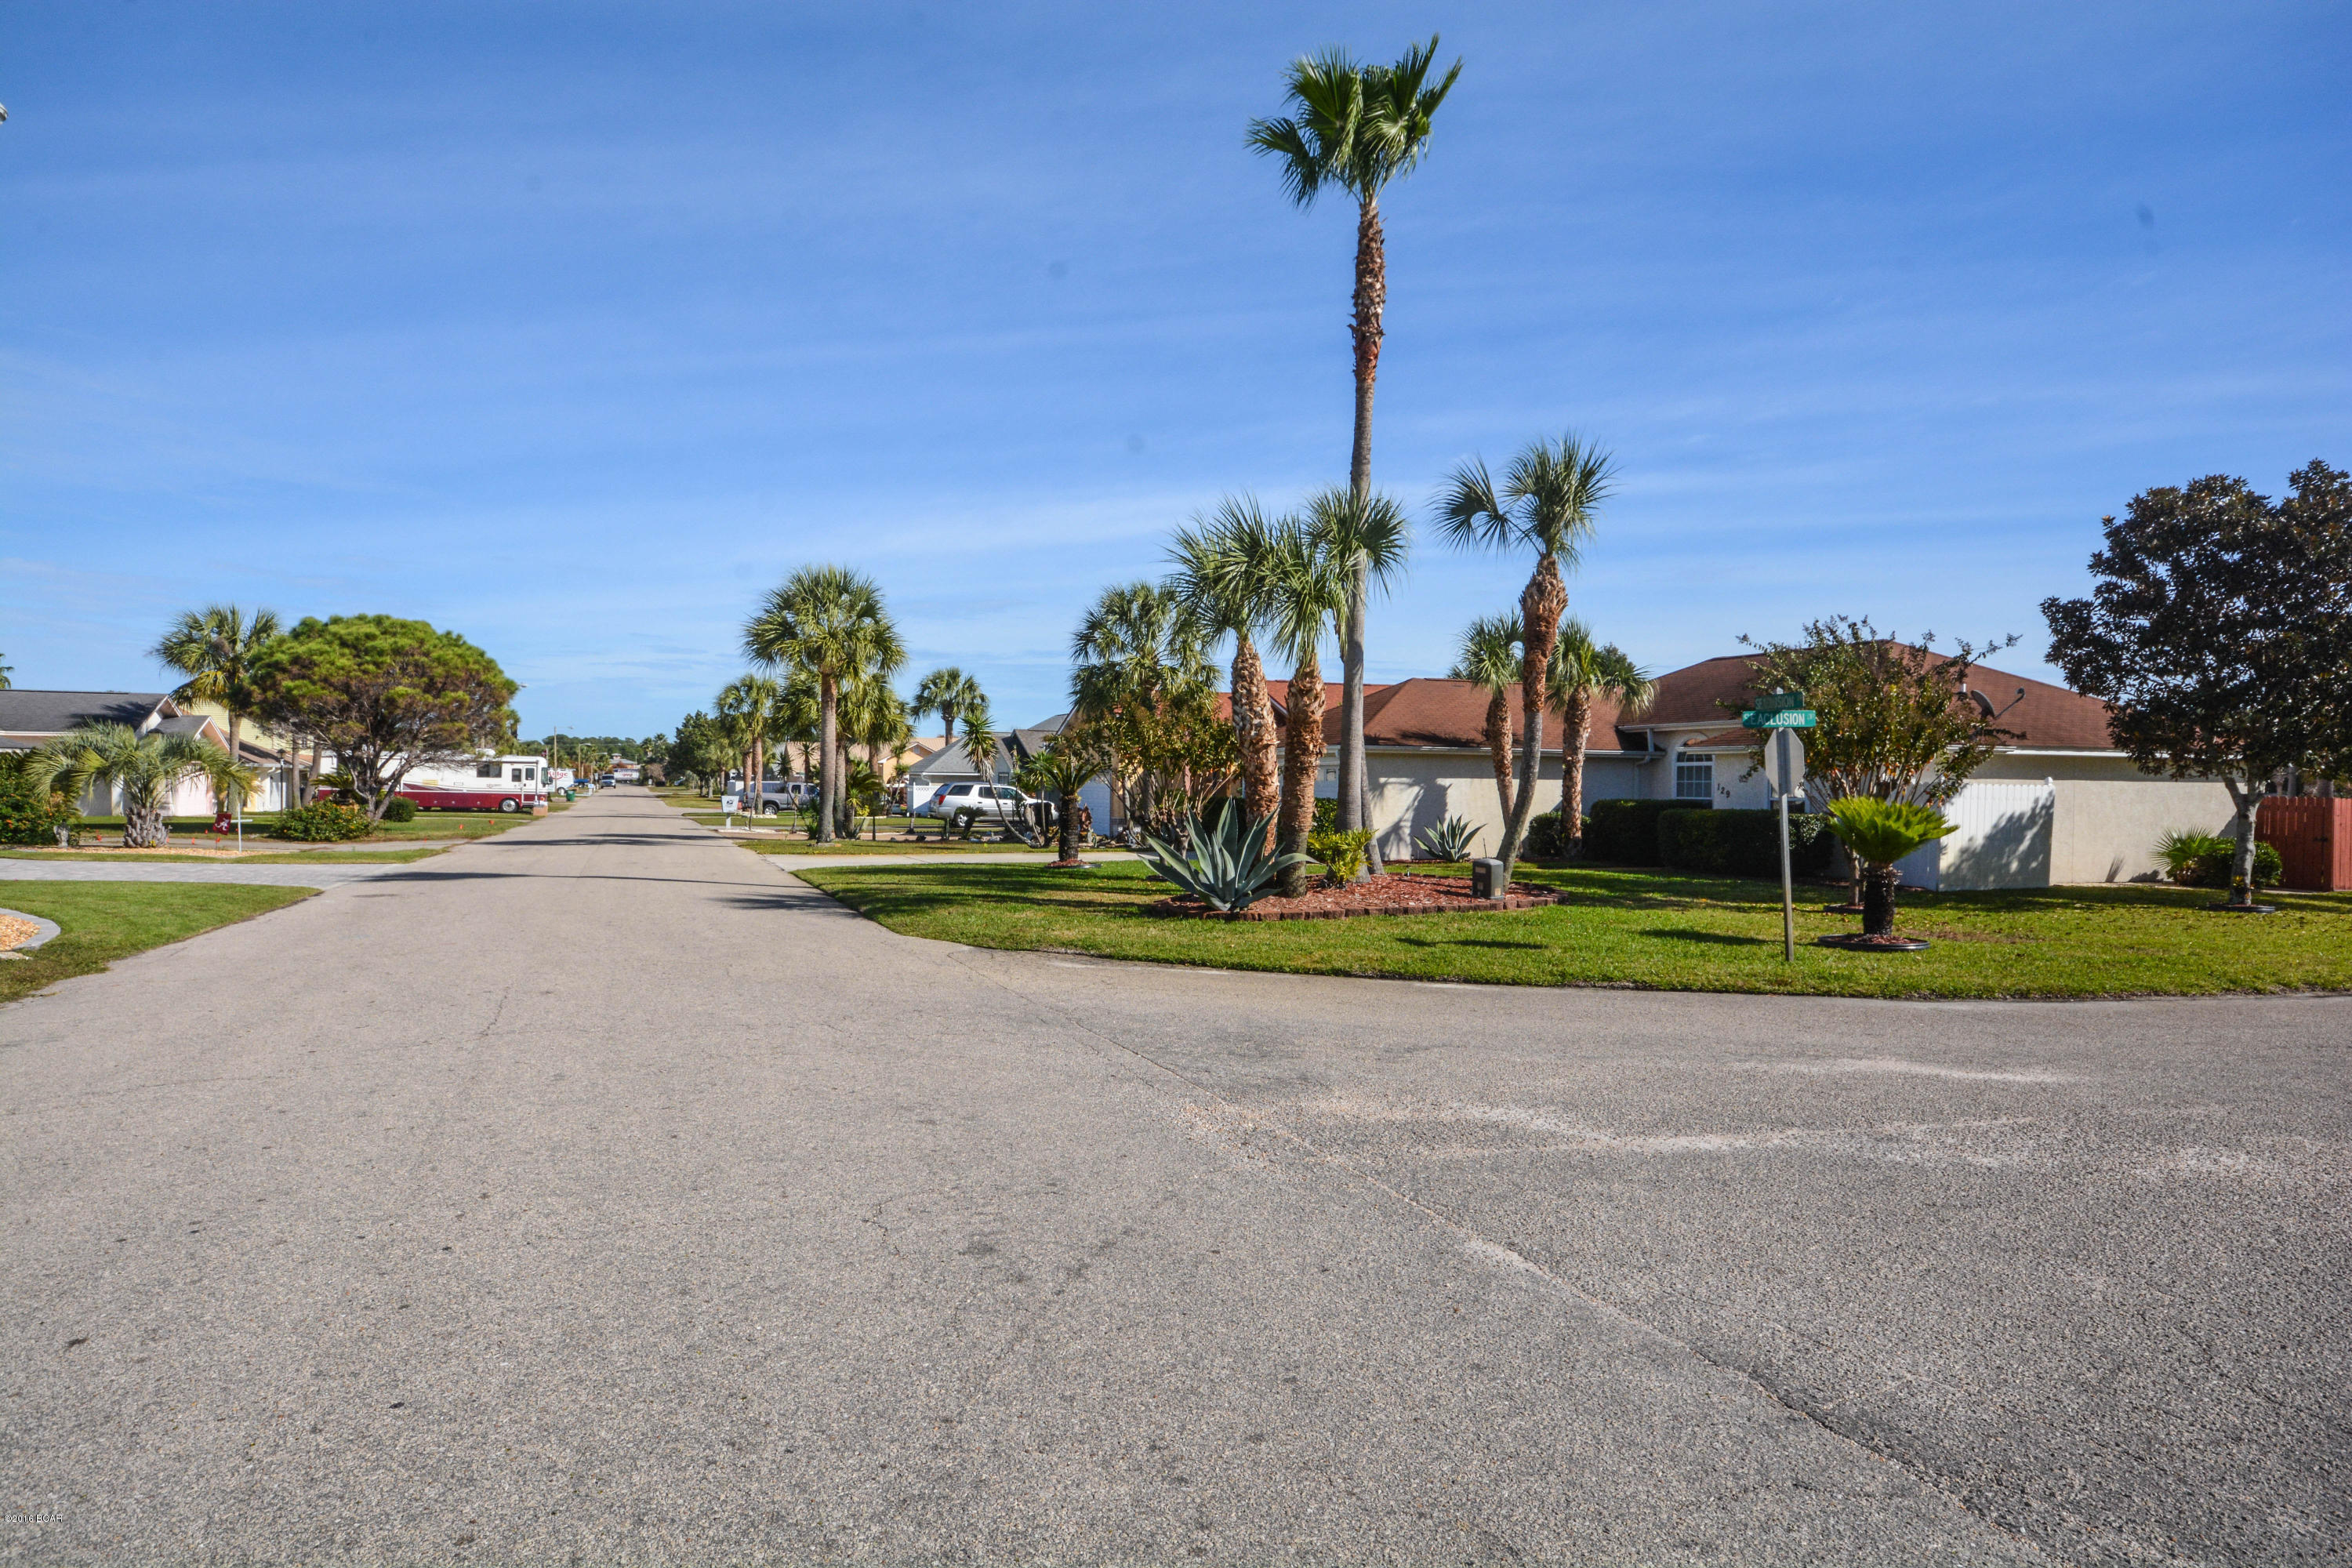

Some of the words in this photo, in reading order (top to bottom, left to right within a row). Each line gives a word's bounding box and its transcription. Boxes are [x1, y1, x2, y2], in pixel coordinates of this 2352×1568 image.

[1755, 695, 1795, 710] SEUSION
[1742, 713, 1806, 725] SEACLUSION
[1717, 782, 1731, 798] 129
